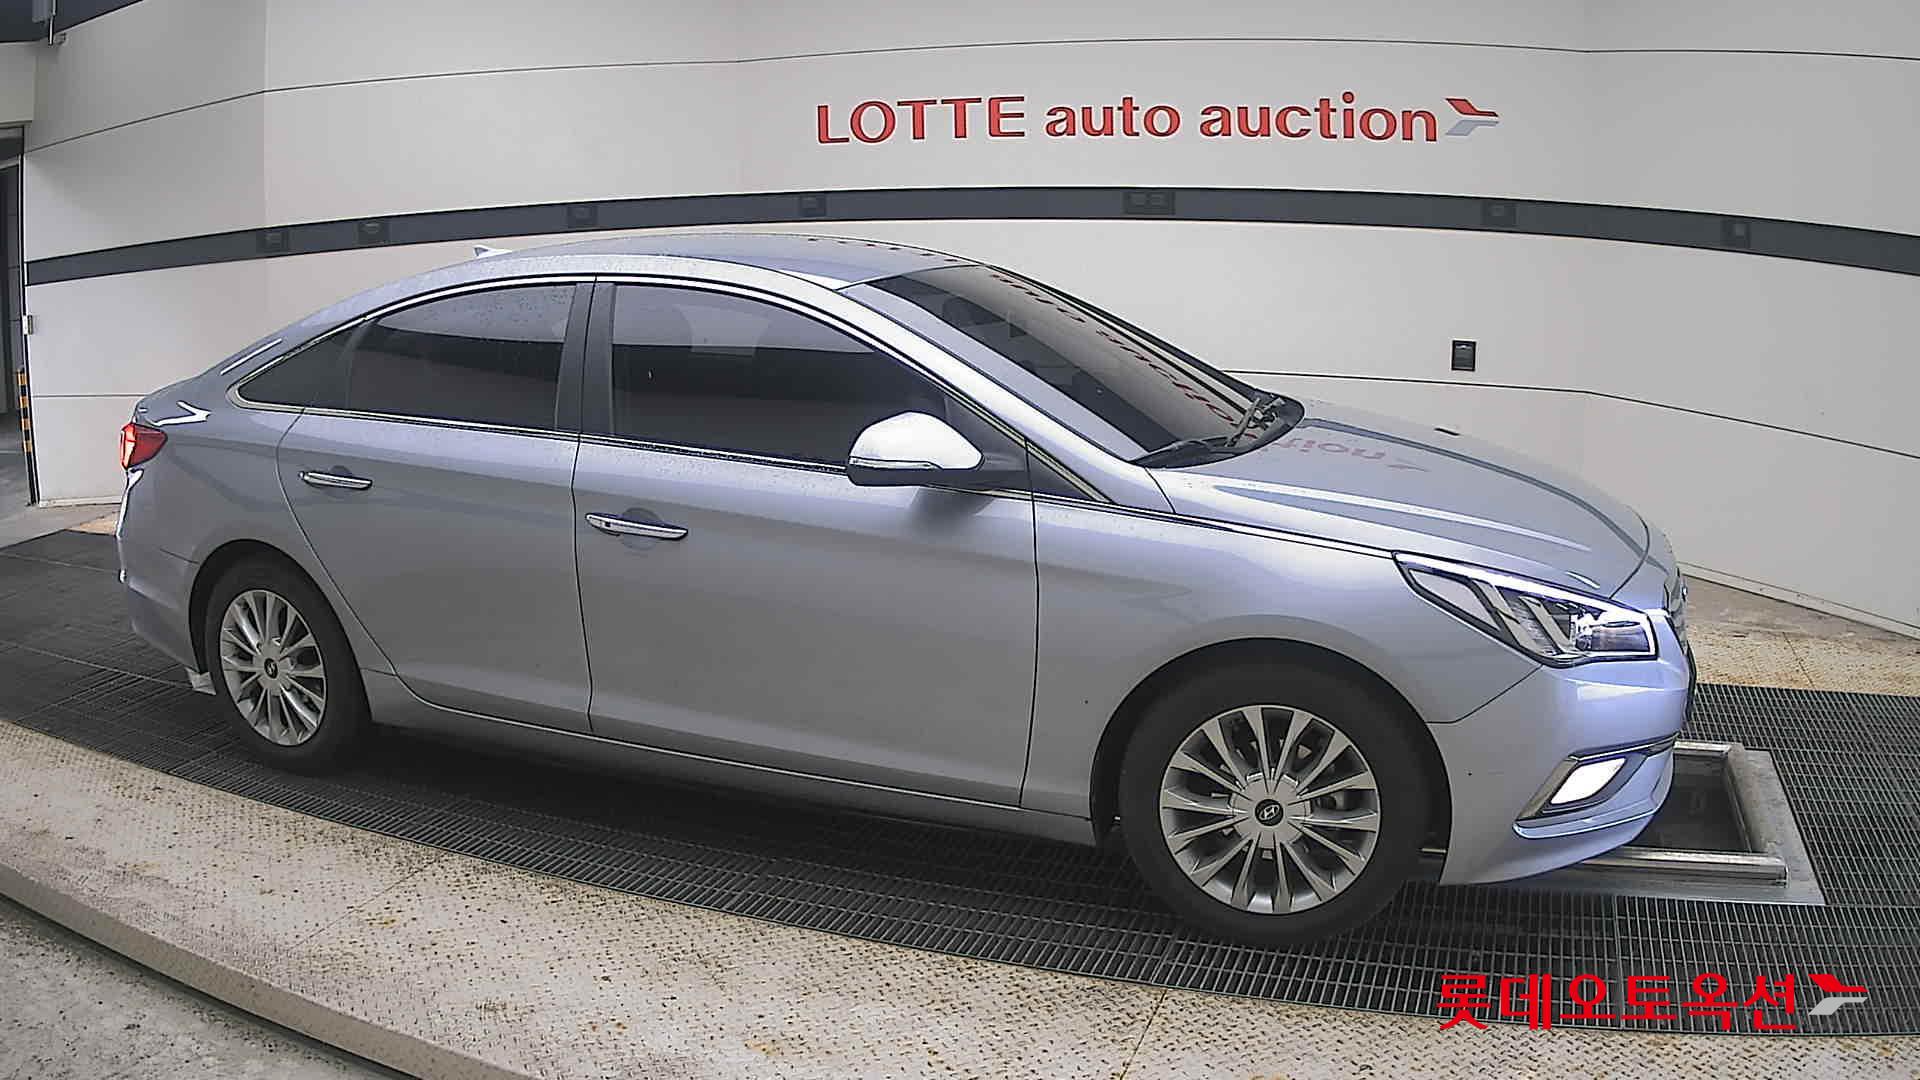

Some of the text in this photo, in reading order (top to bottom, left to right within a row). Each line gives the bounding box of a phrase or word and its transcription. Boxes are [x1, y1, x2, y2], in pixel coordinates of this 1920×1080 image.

[816, 92, 1438, 144] LOTTE auto auction
